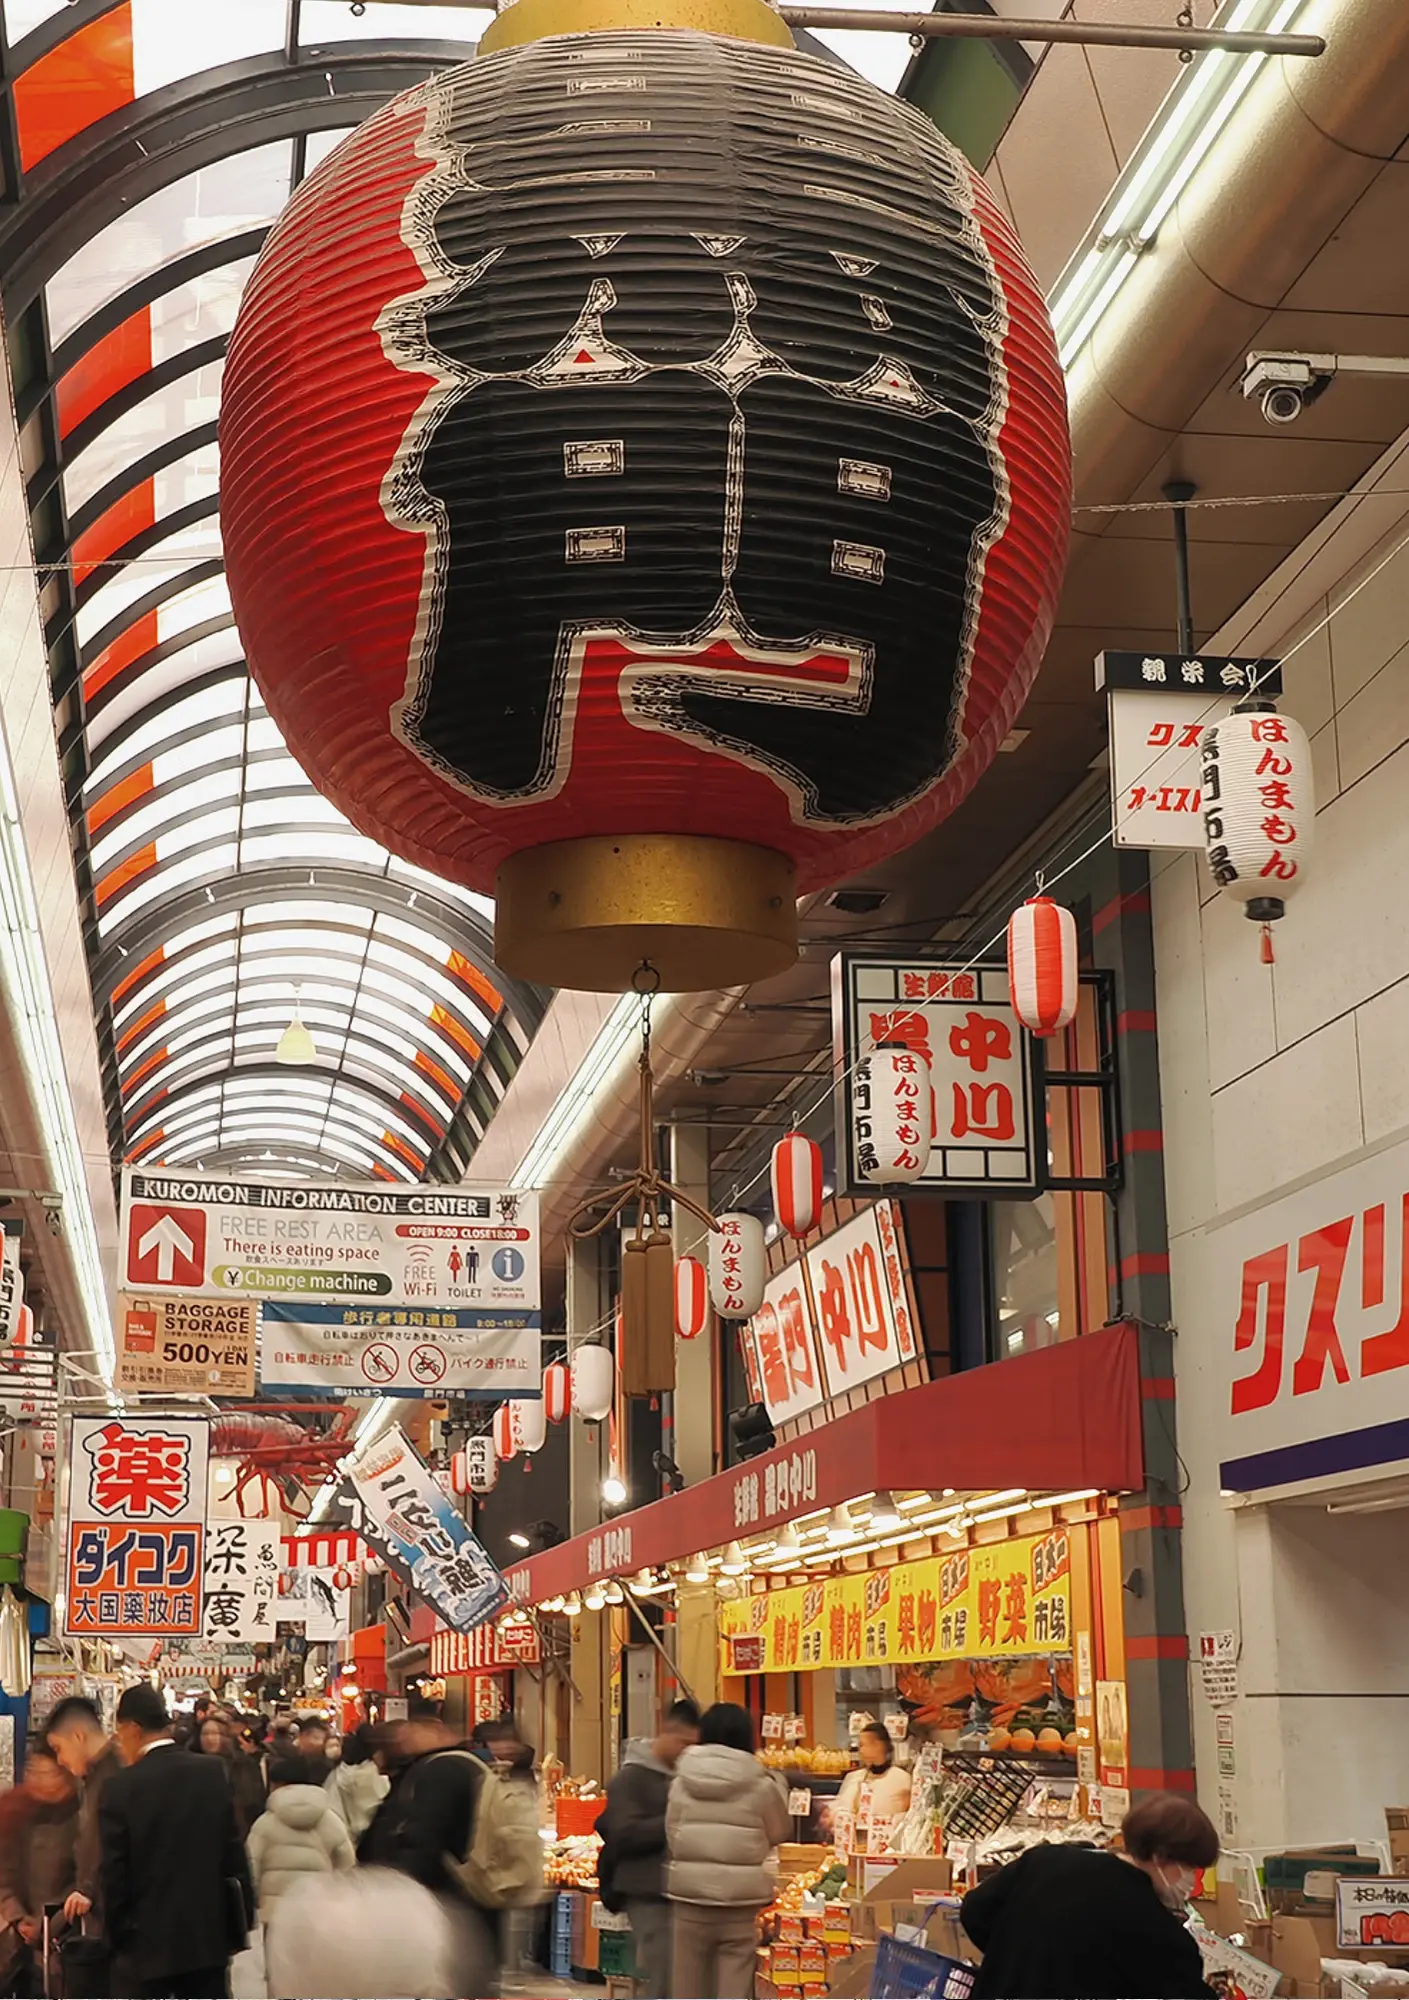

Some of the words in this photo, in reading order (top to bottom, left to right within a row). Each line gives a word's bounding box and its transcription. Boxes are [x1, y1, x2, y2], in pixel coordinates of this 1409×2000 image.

[1147, 723, 1206, 748] クス
[1249, 717, 1298, 881] ほんまもん
[903, 972, 975, 999] 生鮮館
[948, 1012, 1016, 1141] 中川
[892, 1054, 921, 1171] ほんまもん
[143, 1180, 250, 1205] KUROMON
[260, 1189, 398, 1214] INFORMATION
[407, 1197, 480, 1216] CENTER
[220, 1215, 267, 1237] FREE
[274, 1219, 321, 1240] REST
[326, 1222, 384, 1243] AREA
[409, 1226, 435, 1237] OPEN
[437, 1227, 458, 1238] 9:00
[223, 1238, 267, 1255] There
[270, 1241, 283, 1256] is
[287, 1242, 334, 1262] eating
[338, 1246, 380, 1263] space
[720, 1219, 744, 1310] ほんまもん
[244, 1270, 307, 1291] Change
[309, 1273, 379, 1293] machine
[404, 1265, 437, 1281] FREE
[404, 1282, 437, 1297] Wi-Fi
[447, 1288, 482, 1298] TOILET
[164, 1317, 250, 1334] STORAGE
[165, 1303, 250, 1320] BAGGAGE
[273, 1351, 355, 1368] 自転車走行禁止
[450, 1357, 529, 1370] バイク通行禁止
[512, 1403, 525, 1447] んまもん
[84, 1422, 191, 1517] 薬
[469, 1439, 487, 1486] 黒門市場
[76, 1527, 197, 1587] ダイコク
[897, 1589, 937, 1656] 果物
[978, 1571, 1028, 1648] 野菜
[1033, 1596, 1067, 1643] 市場
[940, 1608, 968, 1649] 市場
